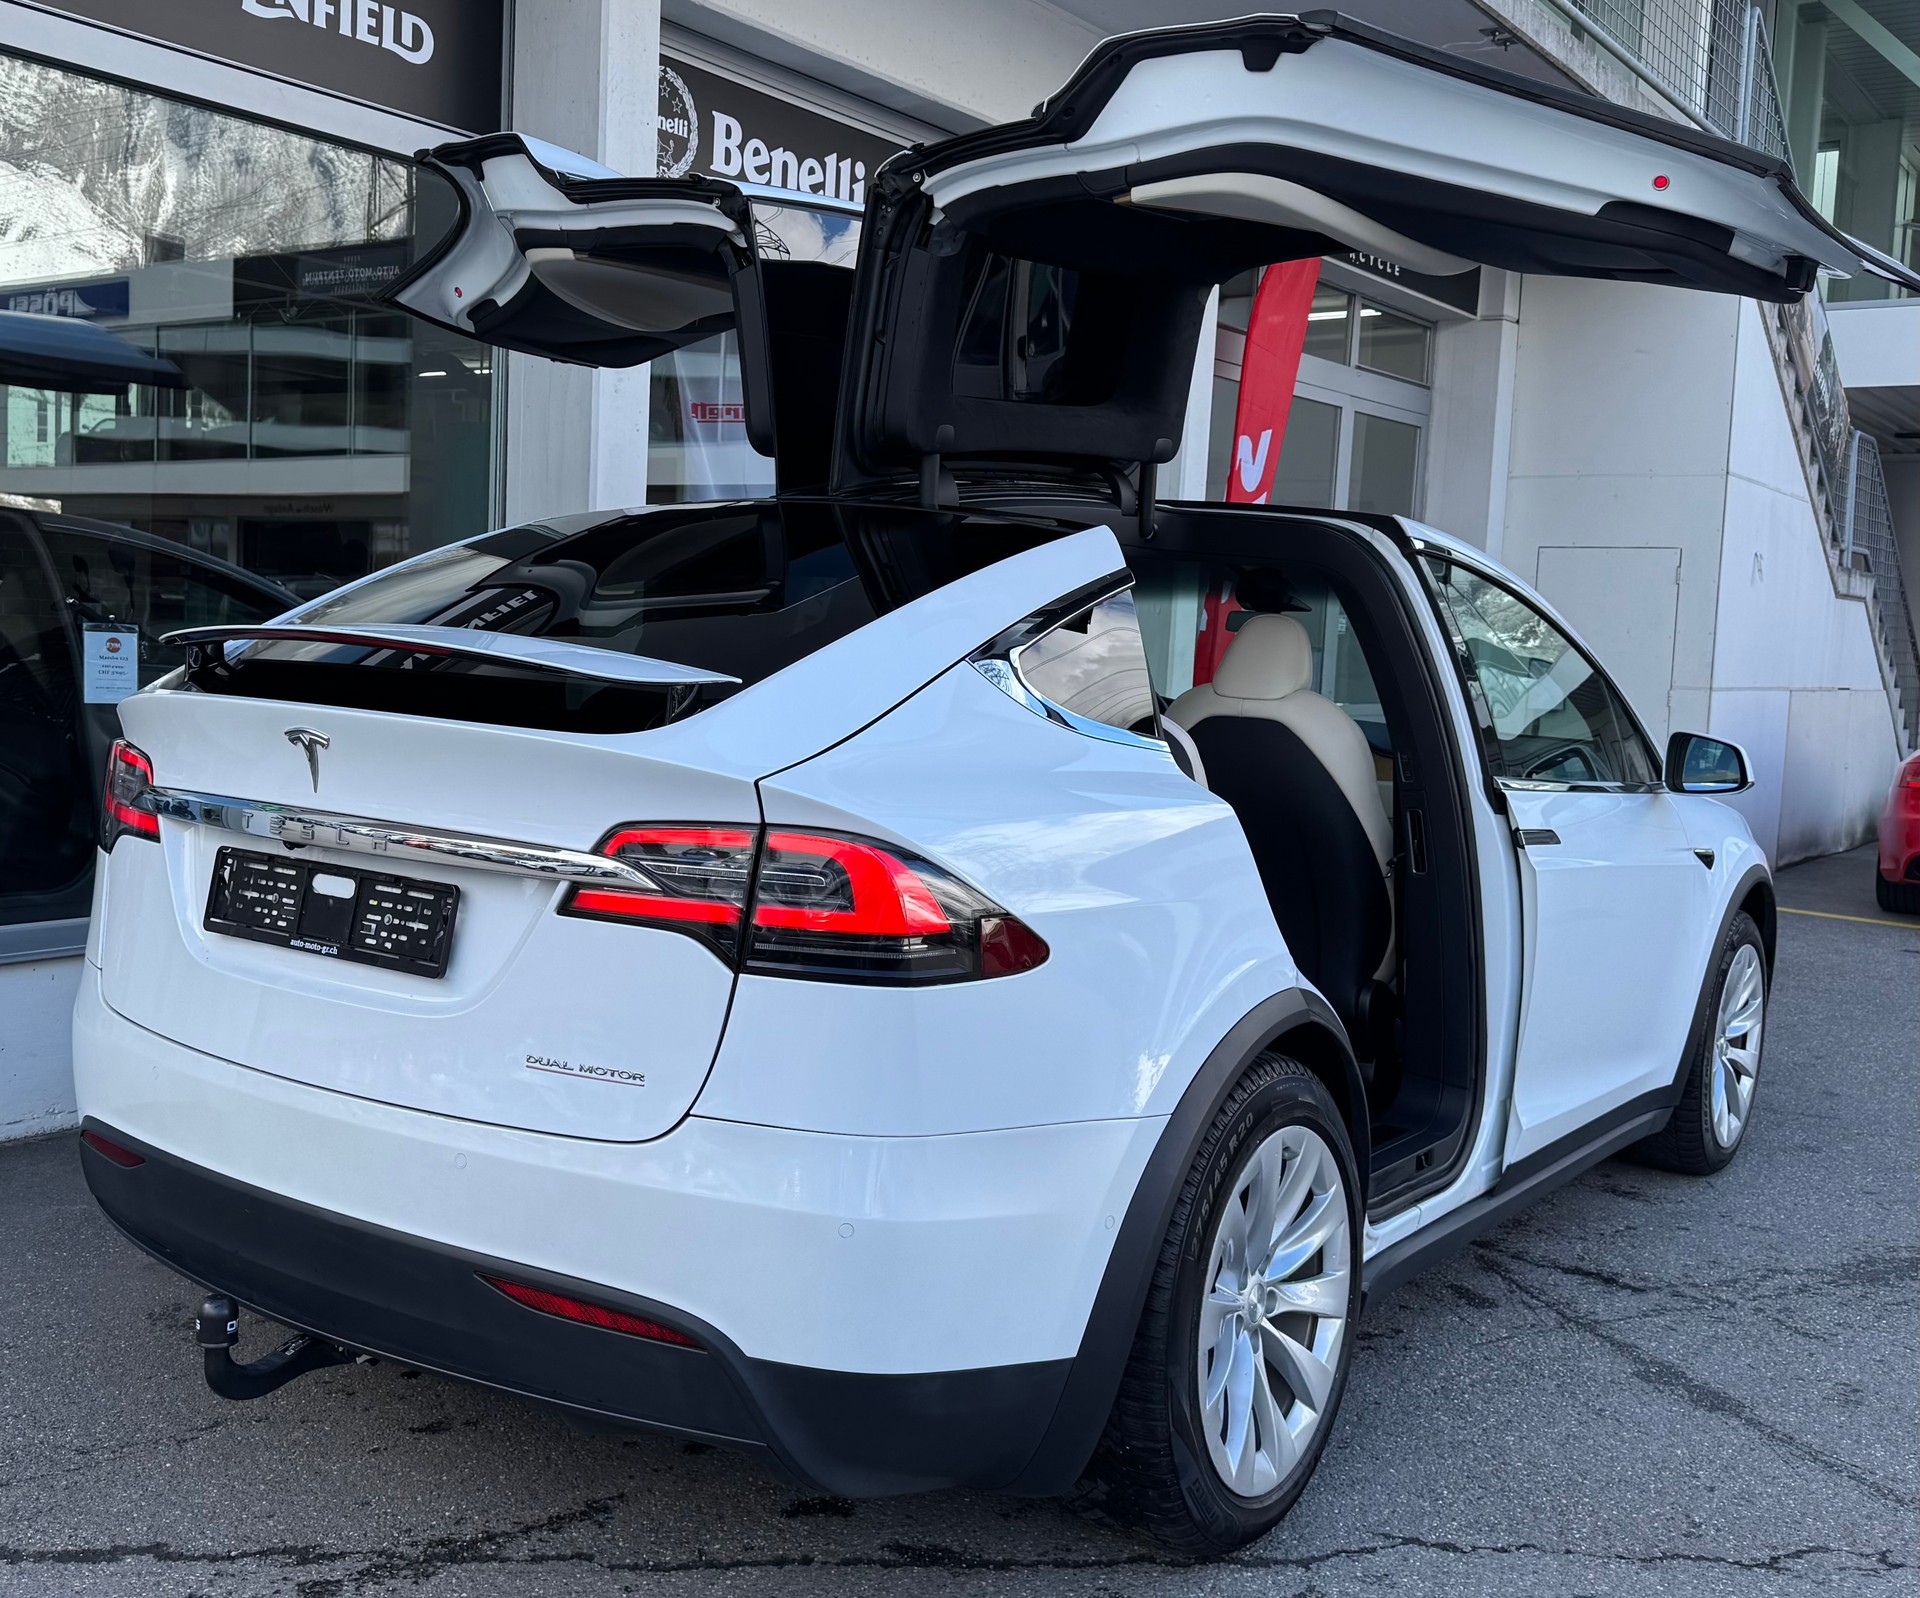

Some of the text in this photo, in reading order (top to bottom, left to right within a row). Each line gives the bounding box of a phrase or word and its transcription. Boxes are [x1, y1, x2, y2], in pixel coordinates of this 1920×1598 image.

[657, 115, 688, 138] nelli
[710, 110, 866, 204] Benelli
[242, 811, 388, 852] TESLA
[526, 1054, 646, 1082] DUAL MOTOR
